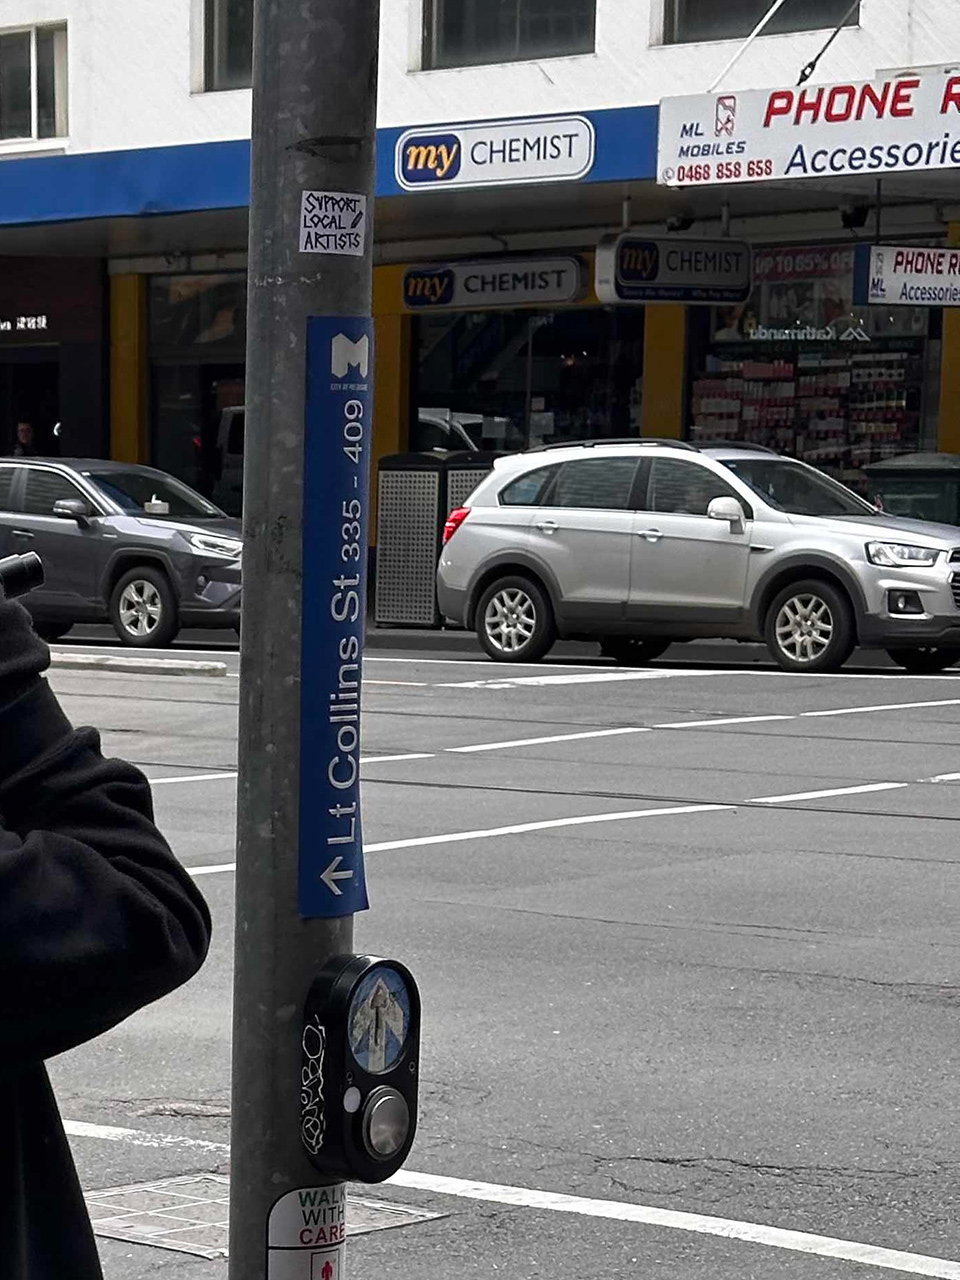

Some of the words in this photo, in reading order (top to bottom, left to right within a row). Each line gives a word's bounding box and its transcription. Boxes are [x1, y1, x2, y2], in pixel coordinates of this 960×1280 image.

[763, 79, 920, 128] PHONE
[680, 122, 704, 138] ML
[407, 143, 458, 177] my
[470, 133, 579, 165] CHEMIST
[678, 141, 746, 158] MOBILES
[677, 163, 710, 182] 0468
[716, 160, 741, 179] 858
[747, 159, 773, 177] 658
[304, 192, 360, 213] SUPPORT
[304, 213, 346, 229] LOCAL
[304, 231, 361, 250] ARTISTS
[622, 248, 656, 278] my
[666, 250, 743, 273] CHEMIST
[893, 251, 945, 274] PHONE
[408, 276, 448, 301] my
[464, 269, 568, 293] CHEMIST
[900, 282, 960, 301] Accessorie
[343, 399, 364, 464] 409
[341, 499, 361, 562] 335
[331, 573, 360, 622] St
[328, 635, 358, 789] Collins
[327, 801, 357, 844] Lt
[299, 1184, 345, 1207] WALK
[302, 1203, 344, 1226] WITH
[300, 1222, 345, 1244] CARE
